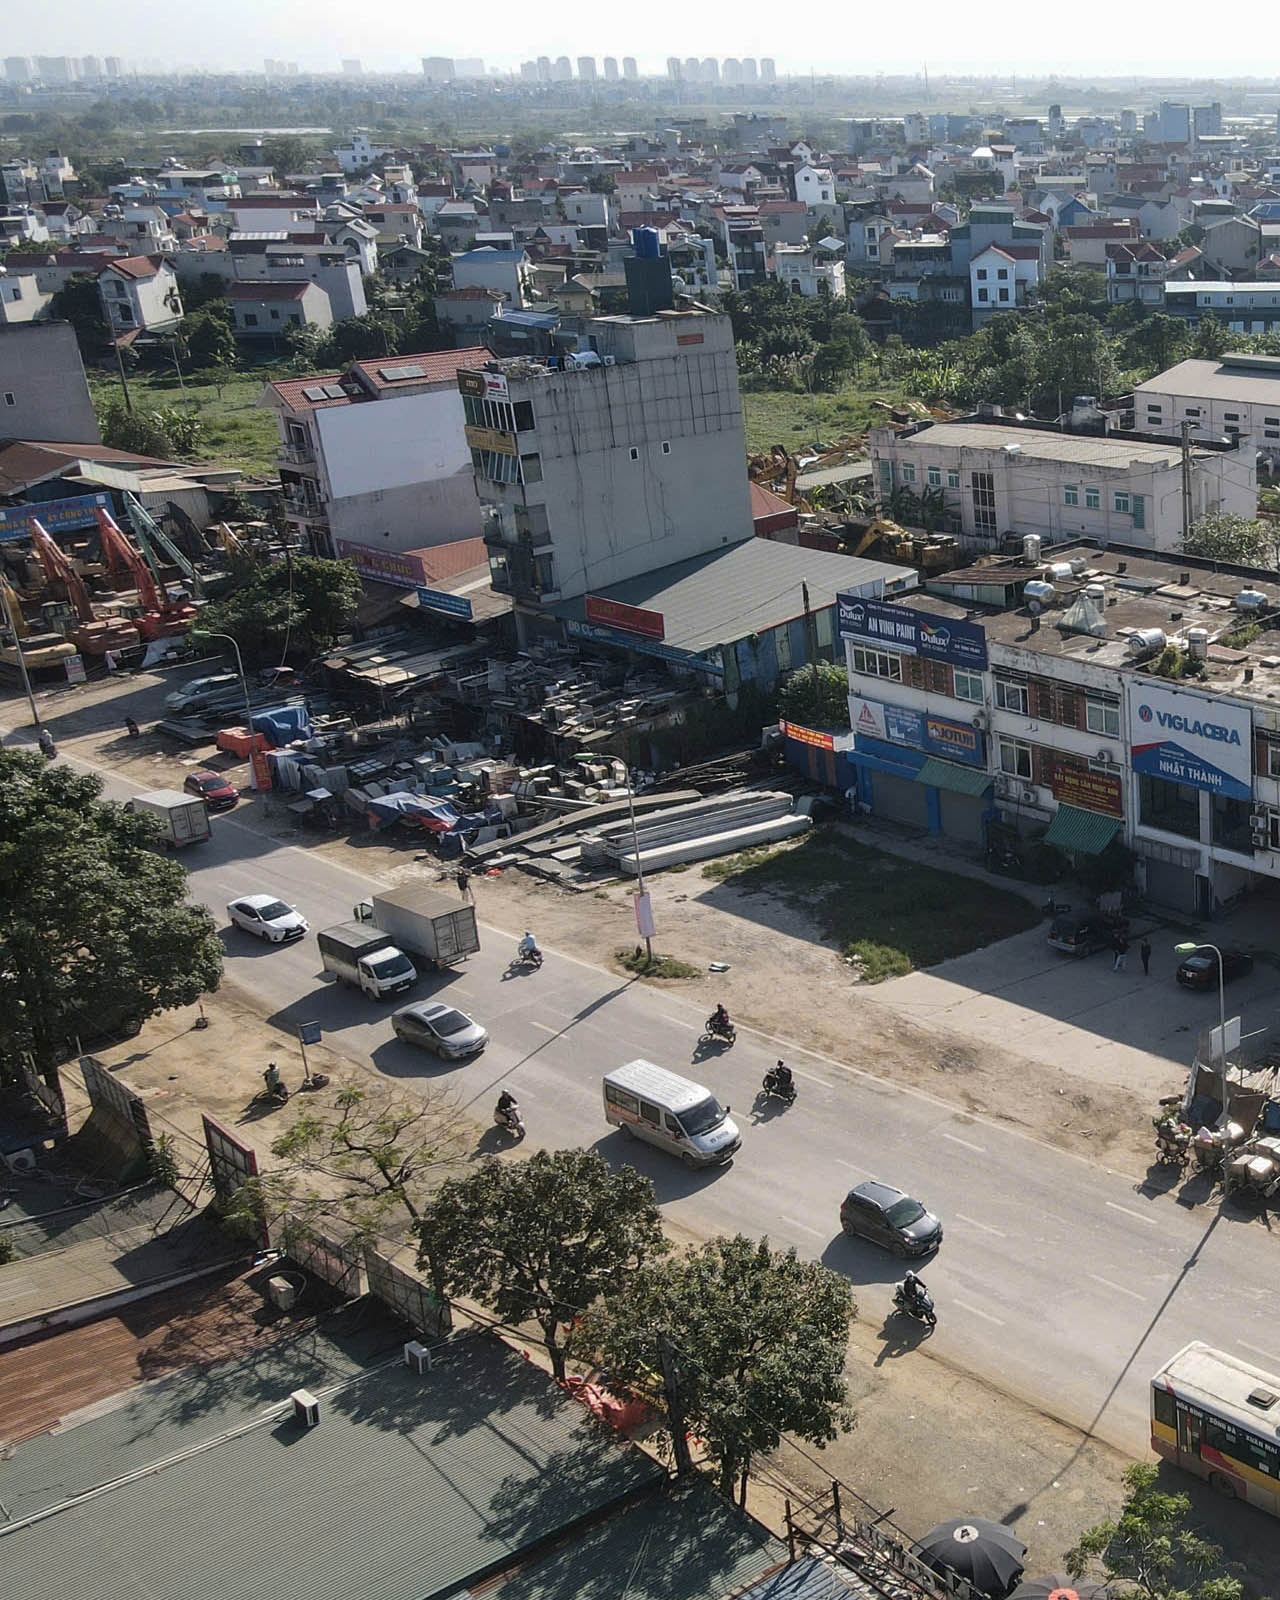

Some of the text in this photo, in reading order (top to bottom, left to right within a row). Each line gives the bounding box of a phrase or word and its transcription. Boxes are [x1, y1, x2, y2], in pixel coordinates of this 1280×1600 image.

[839, 608, 863, 622] Dulux
[896, 622, 916, 641] PAINT
[920, 631, 947, 647] Dulux
[941, 726, 974, 747] JOTUN
[1156, 710, 1241, 746] VIGLACERA
[1160, 760, 1222, 786] NHẬT THÀNH
